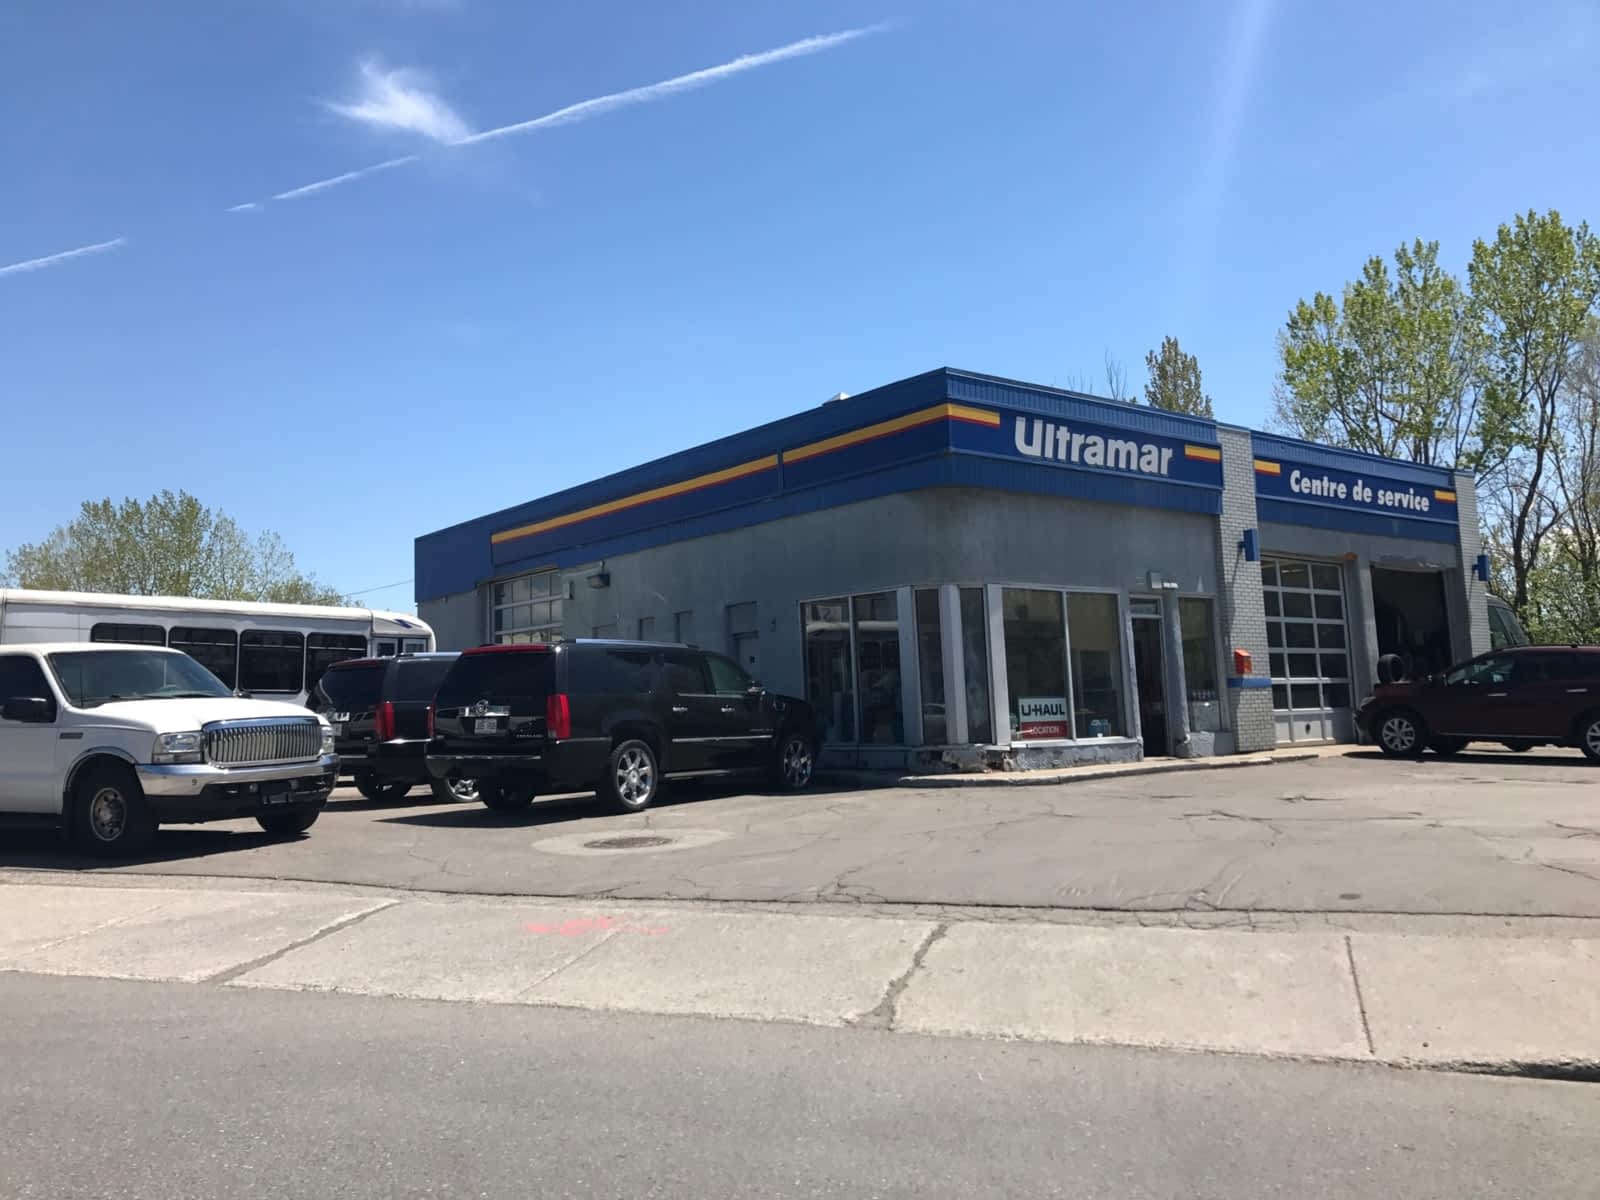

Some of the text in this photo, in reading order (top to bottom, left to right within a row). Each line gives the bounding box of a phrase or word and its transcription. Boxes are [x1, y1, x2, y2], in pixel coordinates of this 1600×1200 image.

[1014, 416, 1173, 475] Ultramar
[1290, 470, 1430, 512] Centre de service
[1021, 703, 1065, 716] U-HAUL
